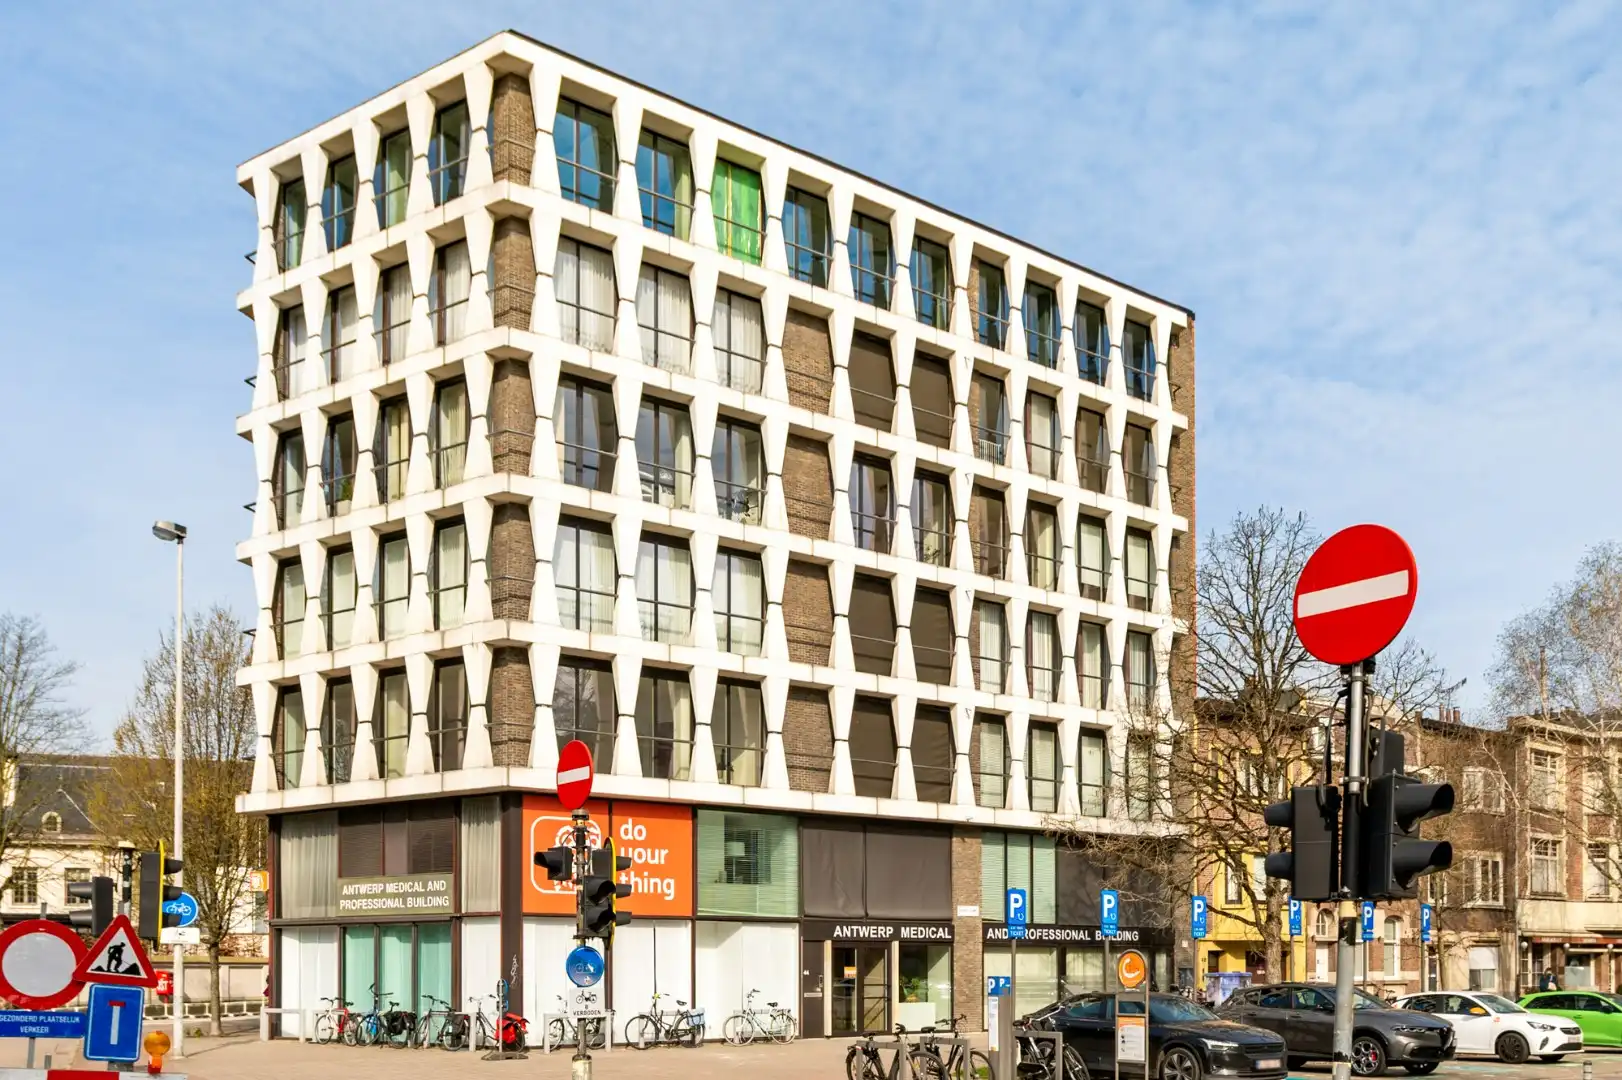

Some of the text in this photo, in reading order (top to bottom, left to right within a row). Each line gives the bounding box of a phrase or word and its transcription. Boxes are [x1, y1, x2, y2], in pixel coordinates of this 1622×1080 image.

[619, 818, 646, 841] do
[342, 880, 447, 895] ANTWERP MEDICAL AND
[619, 871, 675, 900] thing
[339, 896, 449, 910] PROFESSIONAL BUILDING
[1010, 893, 1023, 918] P
[1103, 894, 1115, 918] P
[1193, 899, 1205, 922] P
[833, 925, 952, 939] ANTWERP MEDICAL
[986, 928, 1139, 941] AND ROFESSIONAL BLDING
[0, 1014, 80, 1023] GEZONDERD PLAATSELIJK
[20, 1025, 50, 1033] VERKEER
